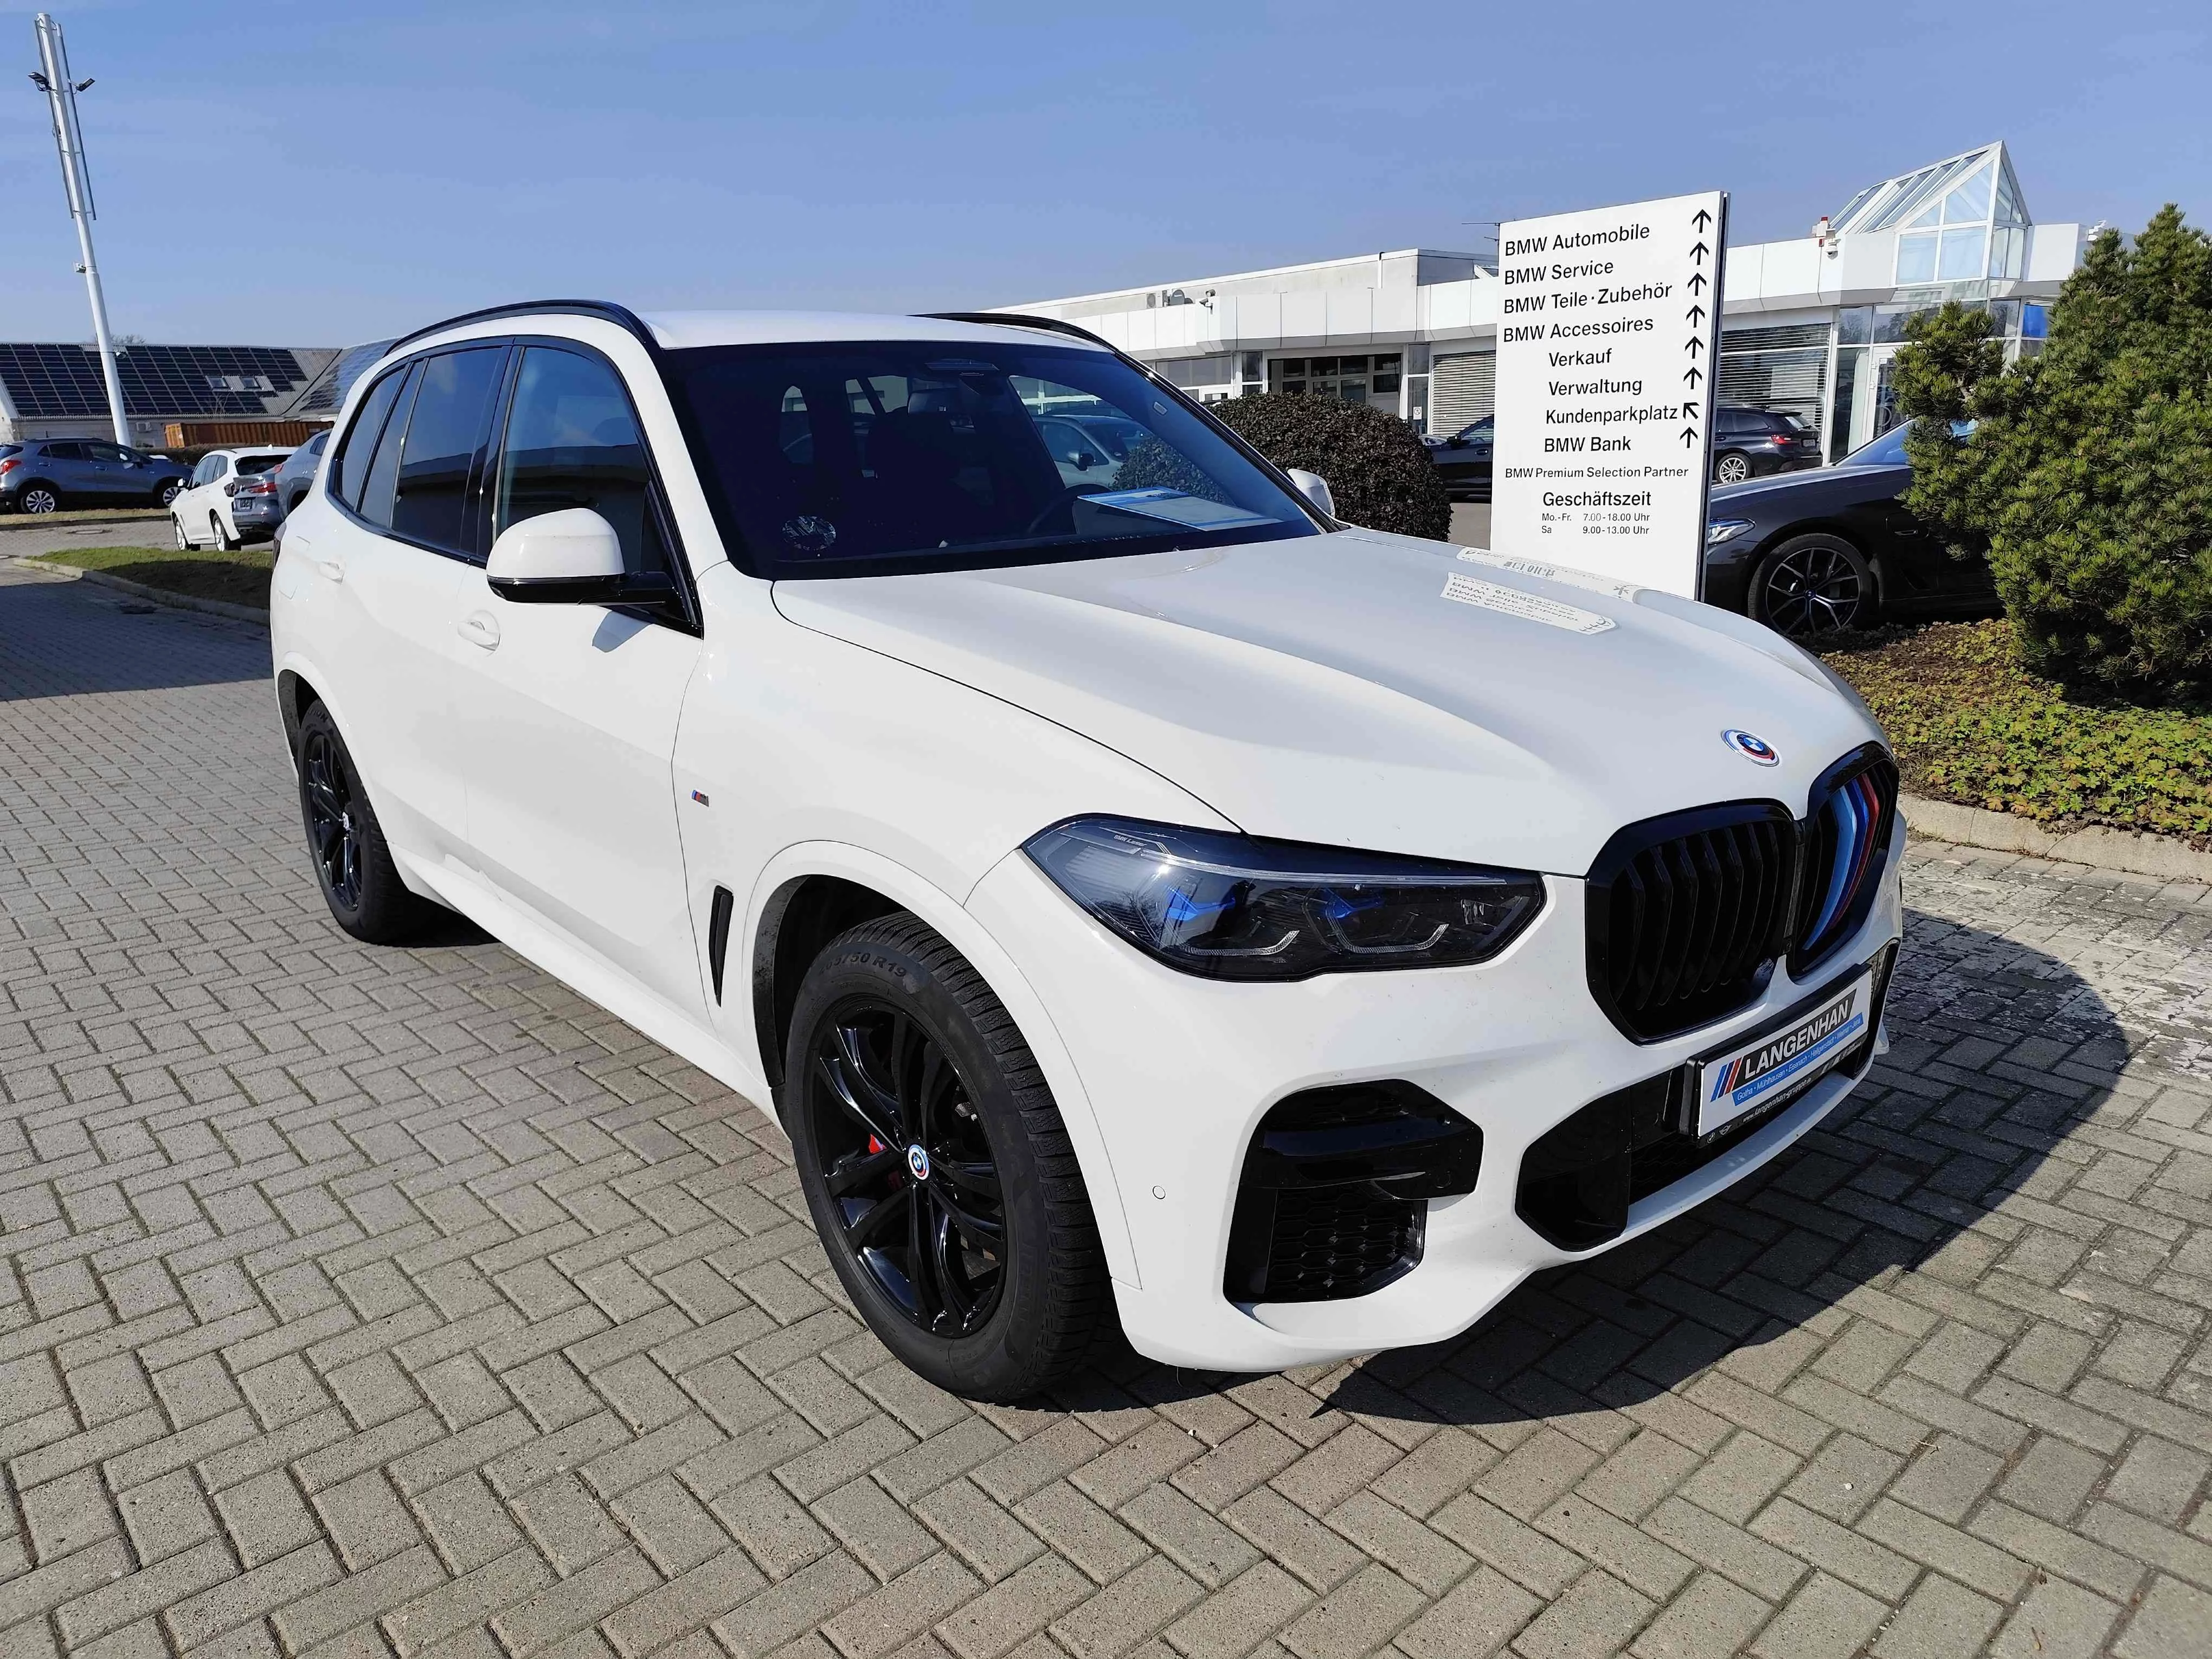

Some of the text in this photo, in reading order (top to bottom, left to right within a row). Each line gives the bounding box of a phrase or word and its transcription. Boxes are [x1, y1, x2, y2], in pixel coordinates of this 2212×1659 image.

[1505, 223, 1650, 256] BMW Automobile
[1504, 260, 1614, 285] BMW Service
[1504, 295, 1546, 314] BMW
[1503, 317, 1654, 343] BMW Accessoires
[1548, 348, 1612, 367] Verkauf
[1548, 378, 1642, 396] Verwaltung
[1546, 405, 1678, 426] Kundenparkplatz
[1544, 435, 1631, 453] BMW Bank
[1505, 466, 1689, 478] BMW Premium Selection Partner
[1543, 491, 1651, 506] Geschäftszeit
[1634, 512, 1650, 522] Uhr
[1541, 525, 1552, 533] Sa
[1633, 525, 1650, 535] Uhr
[1745, 999, 1849, 1080] LANGENHAN
[1737, 1088, 1753, 1101] Gotha
[1757, 1070, 1786, 1091] Mühlhausen
